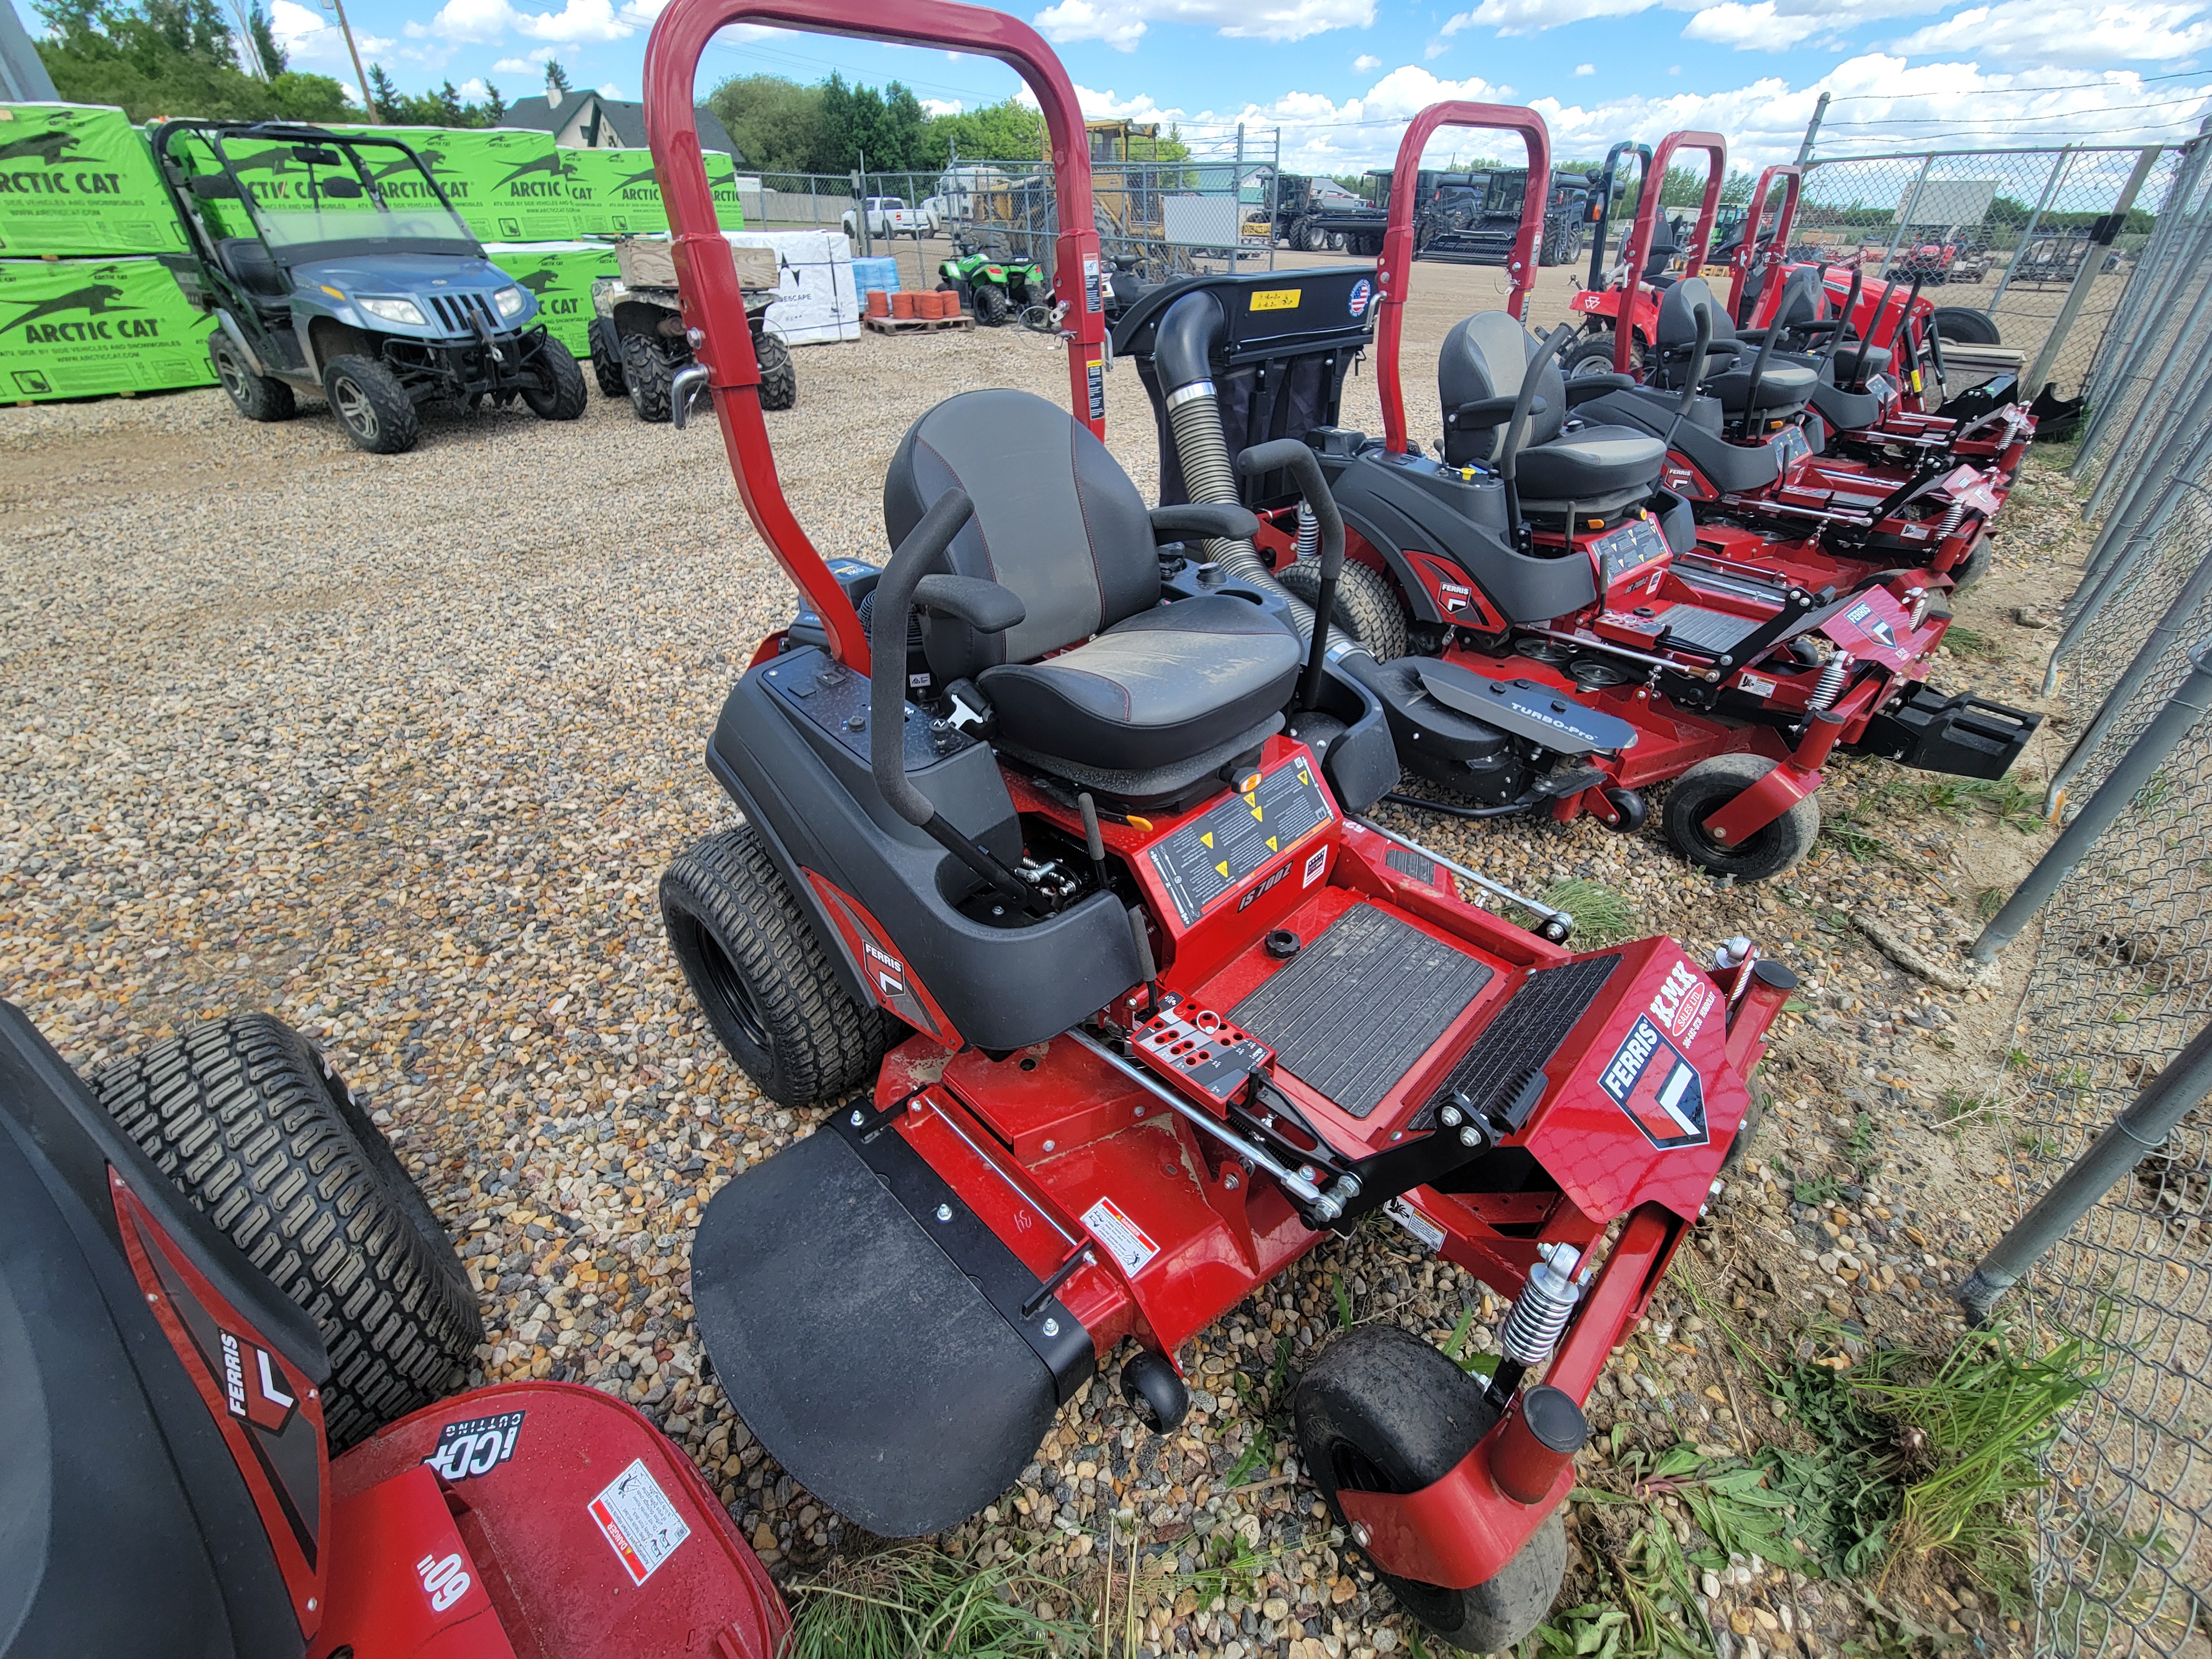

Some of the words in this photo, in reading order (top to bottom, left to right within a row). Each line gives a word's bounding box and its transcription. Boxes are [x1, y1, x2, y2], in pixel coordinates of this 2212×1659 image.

[0, 172, 70, 193] RCTIC
[75, 173, 120, 193] CAT
[247, 181, 290, 199] CTIC
[441, 182, 469, 198] CAT
[511, 182, 561, 198] ARCTIC
[572, 187, 592, 200] CAT
[622, 188, 659, 201] ARCTIC
[551, 298, 578, 314] CAT
[26, 321, 113, 343] ARCTIC
[117, 319, 159, 338] CAT
[1442, 583, 1469, 595] FERRIS
[1847, 604, 1871, 624] FERRIS
[1239, 889, 1255, 911] IS
[1256, 861, 1293, 897] 700Z
[865, 943, 901, 972] FERRIS
[1678, 1003, 1694, 1028] SALES
[1699, 990, 1717, 1019] HUMBOLDT
[1605, 1022, 1658, 1099] FERRIS
[1014, 1210, 1031, 1233] 34
[1121, 1218, 1141, 1237] DANGER
[1420, 1213, 1446, 1235] WARNING
[221, 1334, 246, 1417] FERRIS
[446, 1413, 521, 1436] CUTTING
[607, 1521, 628, 1551] DANGER
